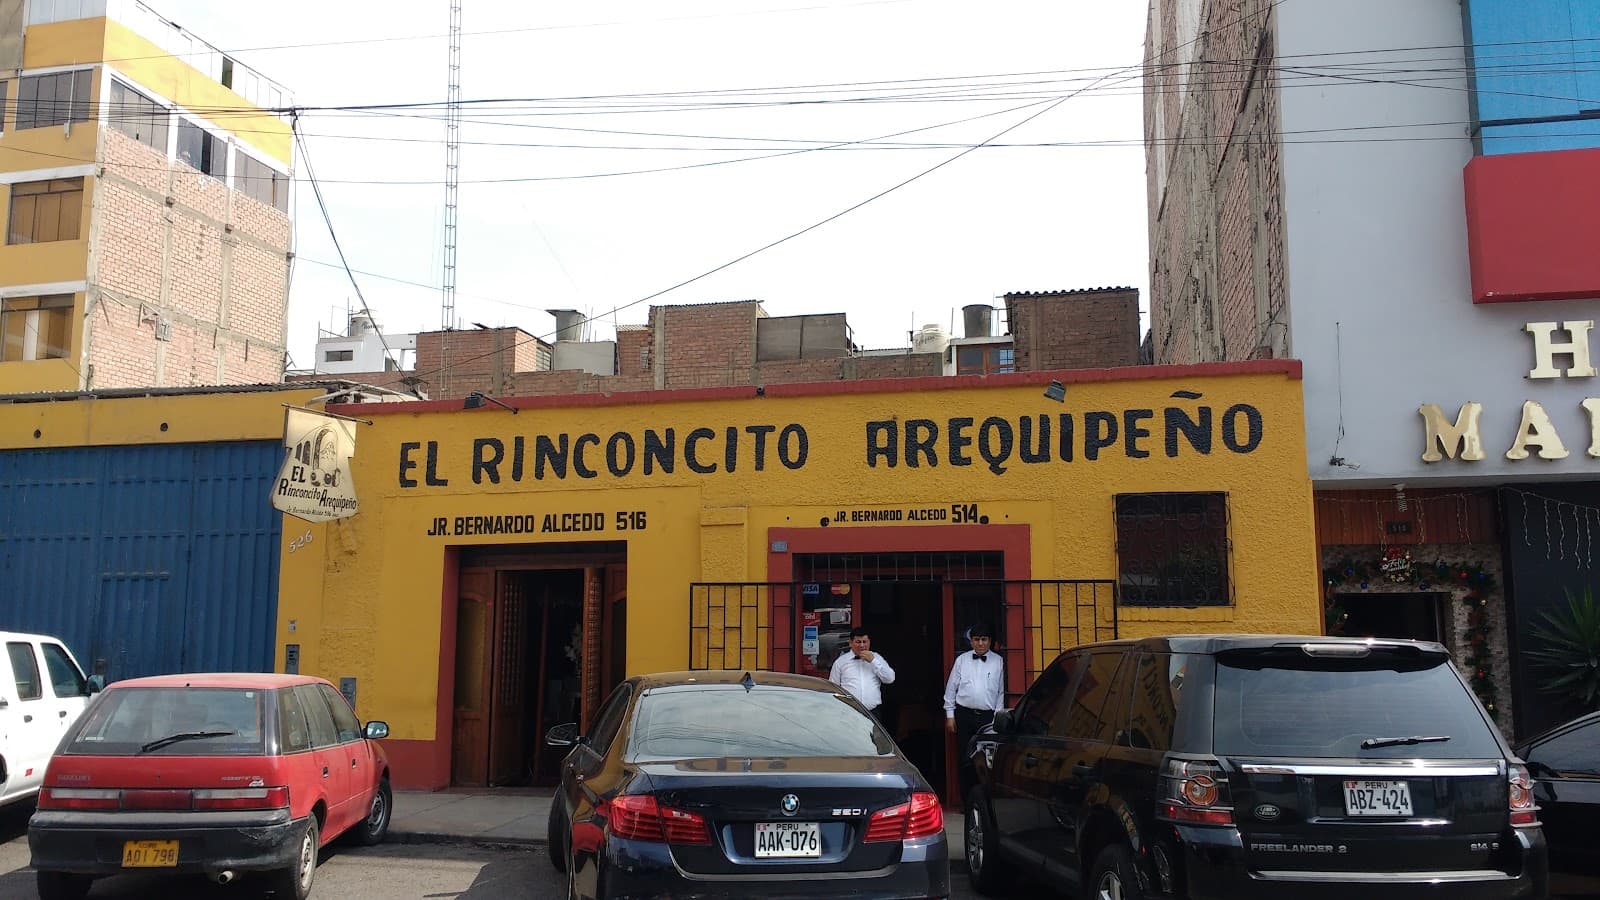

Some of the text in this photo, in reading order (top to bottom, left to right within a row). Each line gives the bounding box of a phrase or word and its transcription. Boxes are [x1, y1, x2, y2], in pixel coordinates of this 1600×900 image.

[399, 390, 1263, 488] EL RINCONCITO AREQUIPEÑO
[1417, 397, 1600, 461] MA
[291, 465, 306, 483] EL
[278, 478, 357, 512] Rinconcito Arequipeño
[427, 511, 647, 536] JR. BERNARDO ALCEDO 516
[833, 504, 978, 523] JR. BERNARDO ALCEDO 514
[288, 529, 313, 553] 526
[1365, 781, 1388, 789] PERU
[1349, 789, 1409, 810] ABZ-424
[776, 823, 799, 831] PERU
[758, 830, 817, 852] AAK-076
[1250, 843, 1334, 853] FREELANDER
